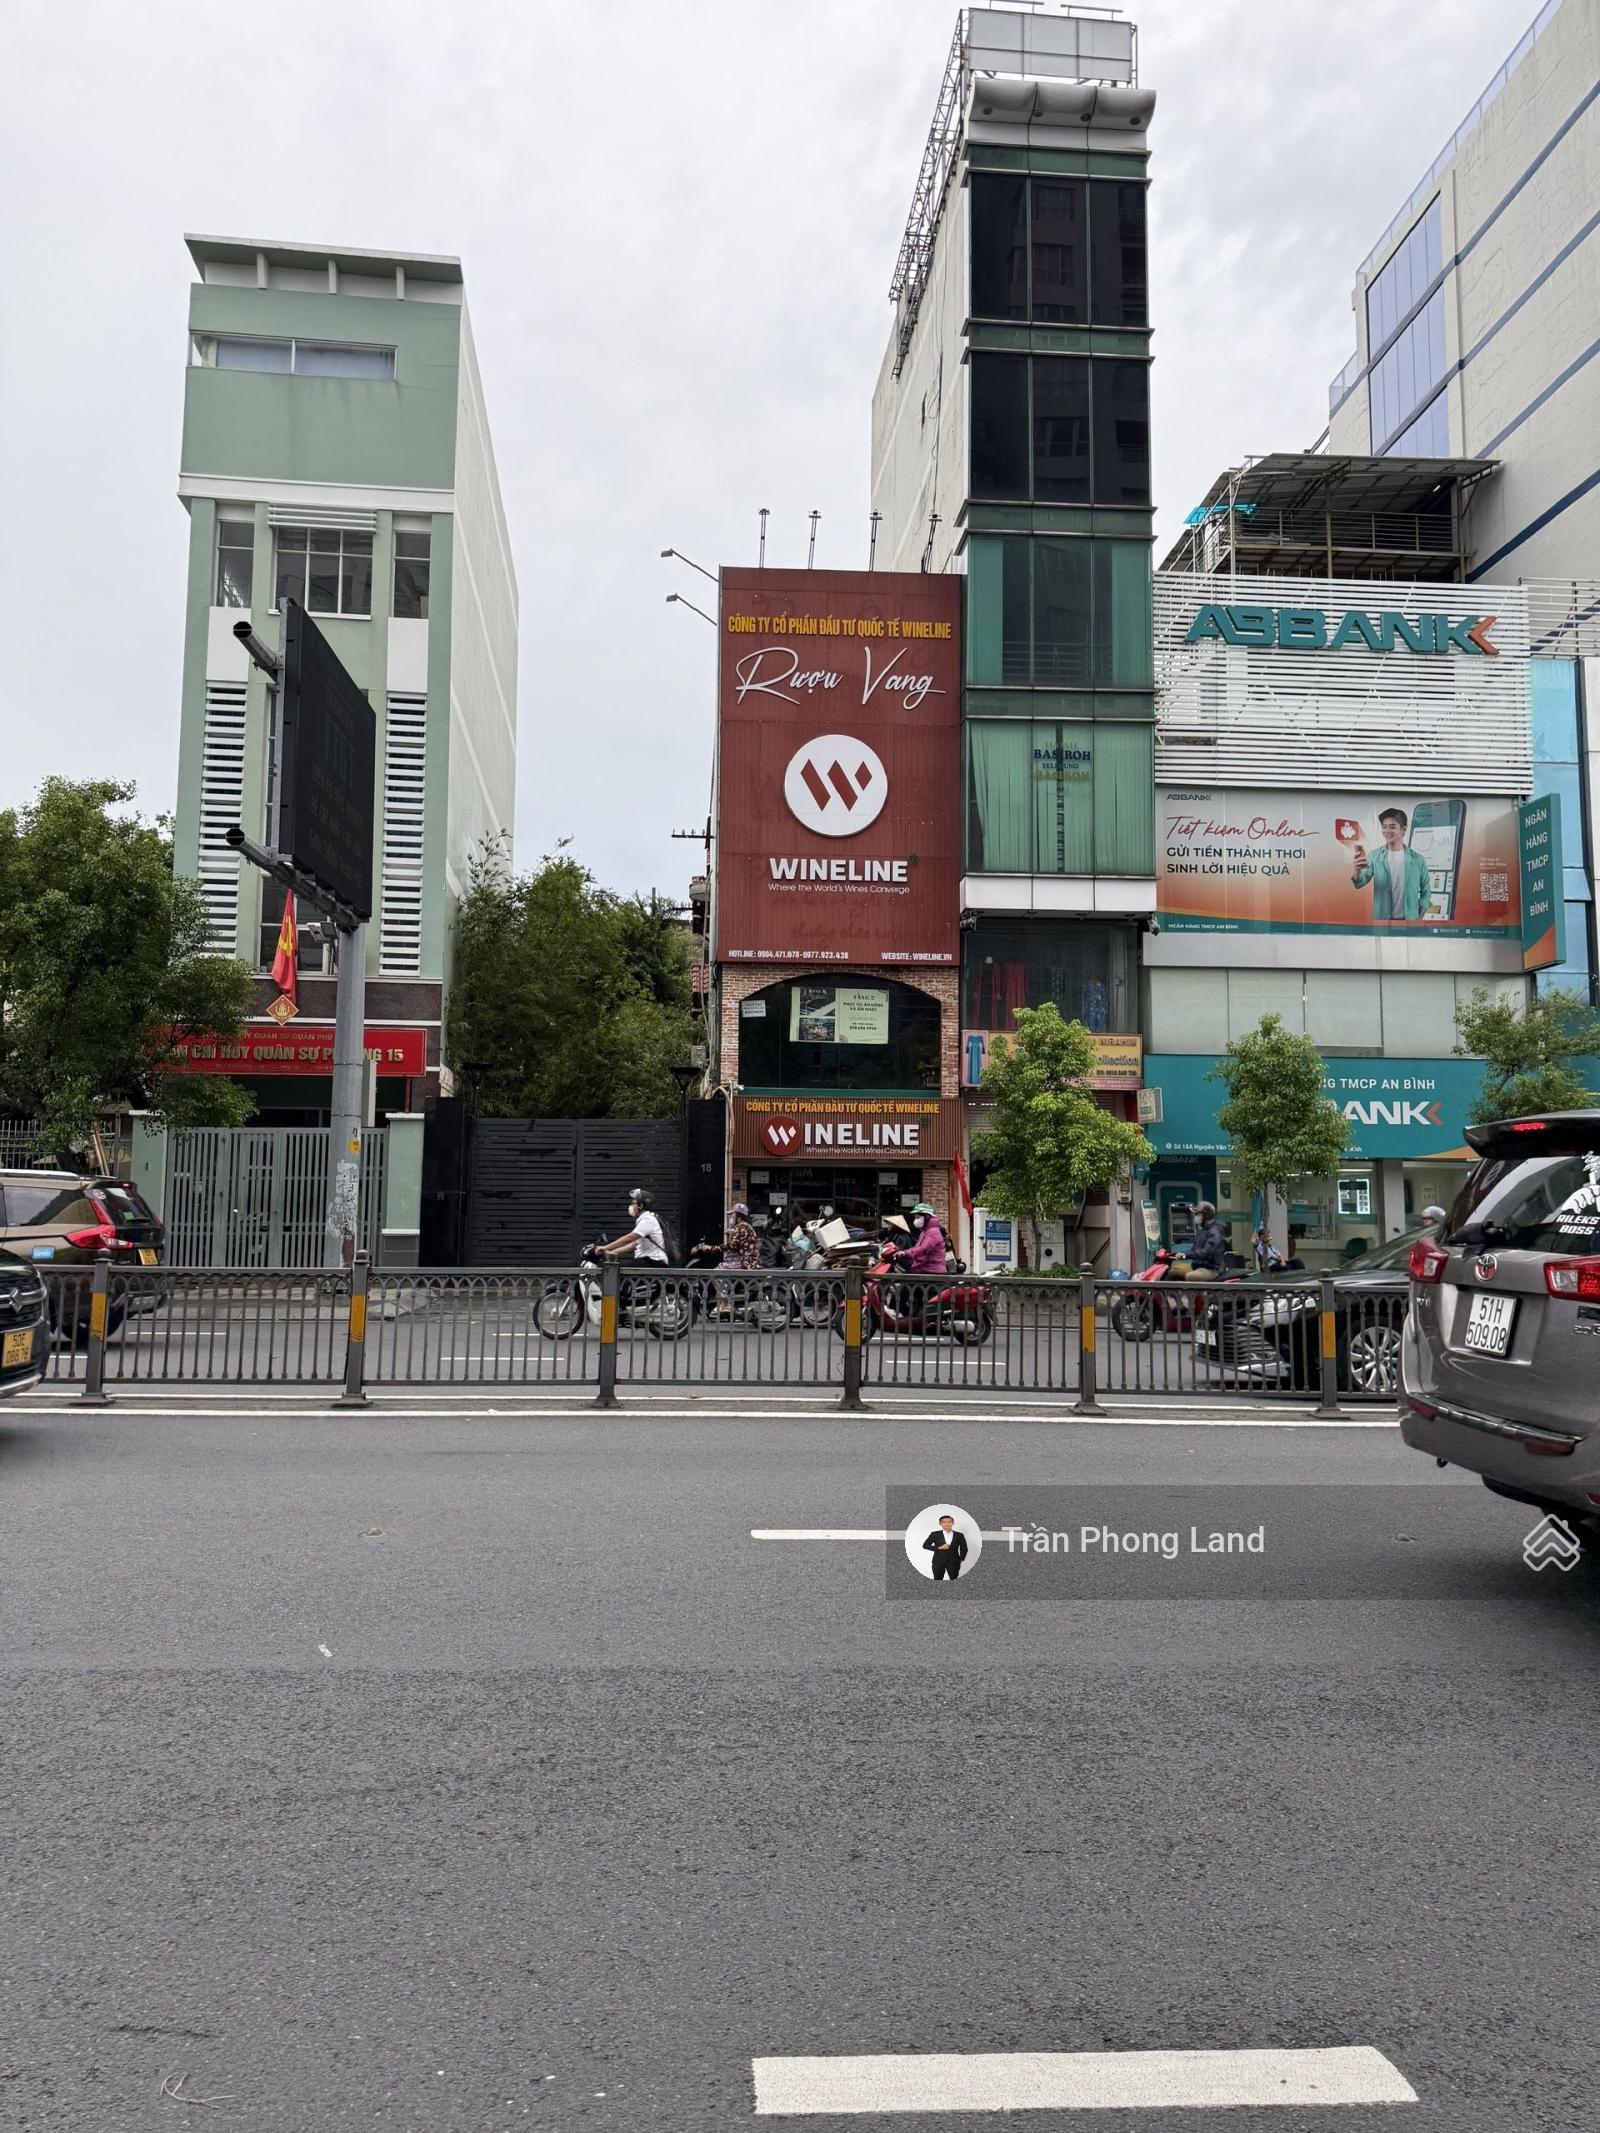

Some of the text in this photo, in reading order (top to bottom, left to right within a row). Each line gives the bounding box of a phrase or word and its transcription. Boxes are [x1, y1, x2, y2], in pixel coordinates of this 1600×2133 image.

[728, 612, 756, 633] CÔNG
[758, 616, 771, 633] TY
[773, 611, 787, 634] CỔ
[842, 618, 856, 636] TƯ
[858, 616, 885, 638] QUỐC
[887, 617, 900, 637] TẾ
[902, 621, 952, 638] WINELINE
[1184, 604, 1499, 655] ABBANK
[735, 646, 947, 709] Rượu Vang
[1034, 749, 1091, 760] BASROH
[1166, 793, 1212, 801] ABBANK
[1525, 808, 1547, 828] NGÂN
[1166, 816, 1320, 840] Tiết kiệm Online
[1526, 831, 1548, 850] HÀNG
[1167, 843, 1190, 858] GỬI
[1226, 845, 1272, 859] THÀNH
[1274, 847, 1306, 859] THƠI
[769, 858, 908, 882] WINELINE
[1167, 862, 1290, 877] SINH LỜI HIỆU QUẢ
[1526, 854, 1549, 871] TMCP
[768, 883, 910, 895] Where the World's Wines Converge
[1532, 879, 1544, 894] AN
[1530, 900, 1549, 916] BÌNH
[728, 949, 756, 958] HOTLINE:
[881, 952, 912, 960] WEBSITE:
[253, 1044, 294, 1061] QUÂN
[299, 1046, 321, 1063] SỰ
[387, 1048, 404, 1062] 15
[1340, 1078, 1377, 1089] TMCP
[1381, 1079, 1399, 1089] AN
[1403, 1077, 1435, 1090] BÌNH
[746, 1099, 770, 1111] CÔNG
[772, 1102, 783, 1112] TY
[785, 1098, 798, 1112] CỔ
[845, 1102, 856, 1113] TƯ
[858, 1099, 882, 1114] QUỐC
[895, 1103, 940, 1114] WINELINE
[701, 1162, 712, 1173] 18
[1556, 1214, 1600, 1225] RILEKS
[1559, 1225, 1595, 1235] BOSS
[1479, 1297, 1505, 1324] 51H
[1466, 1322, 1507, 1350] 509.08
